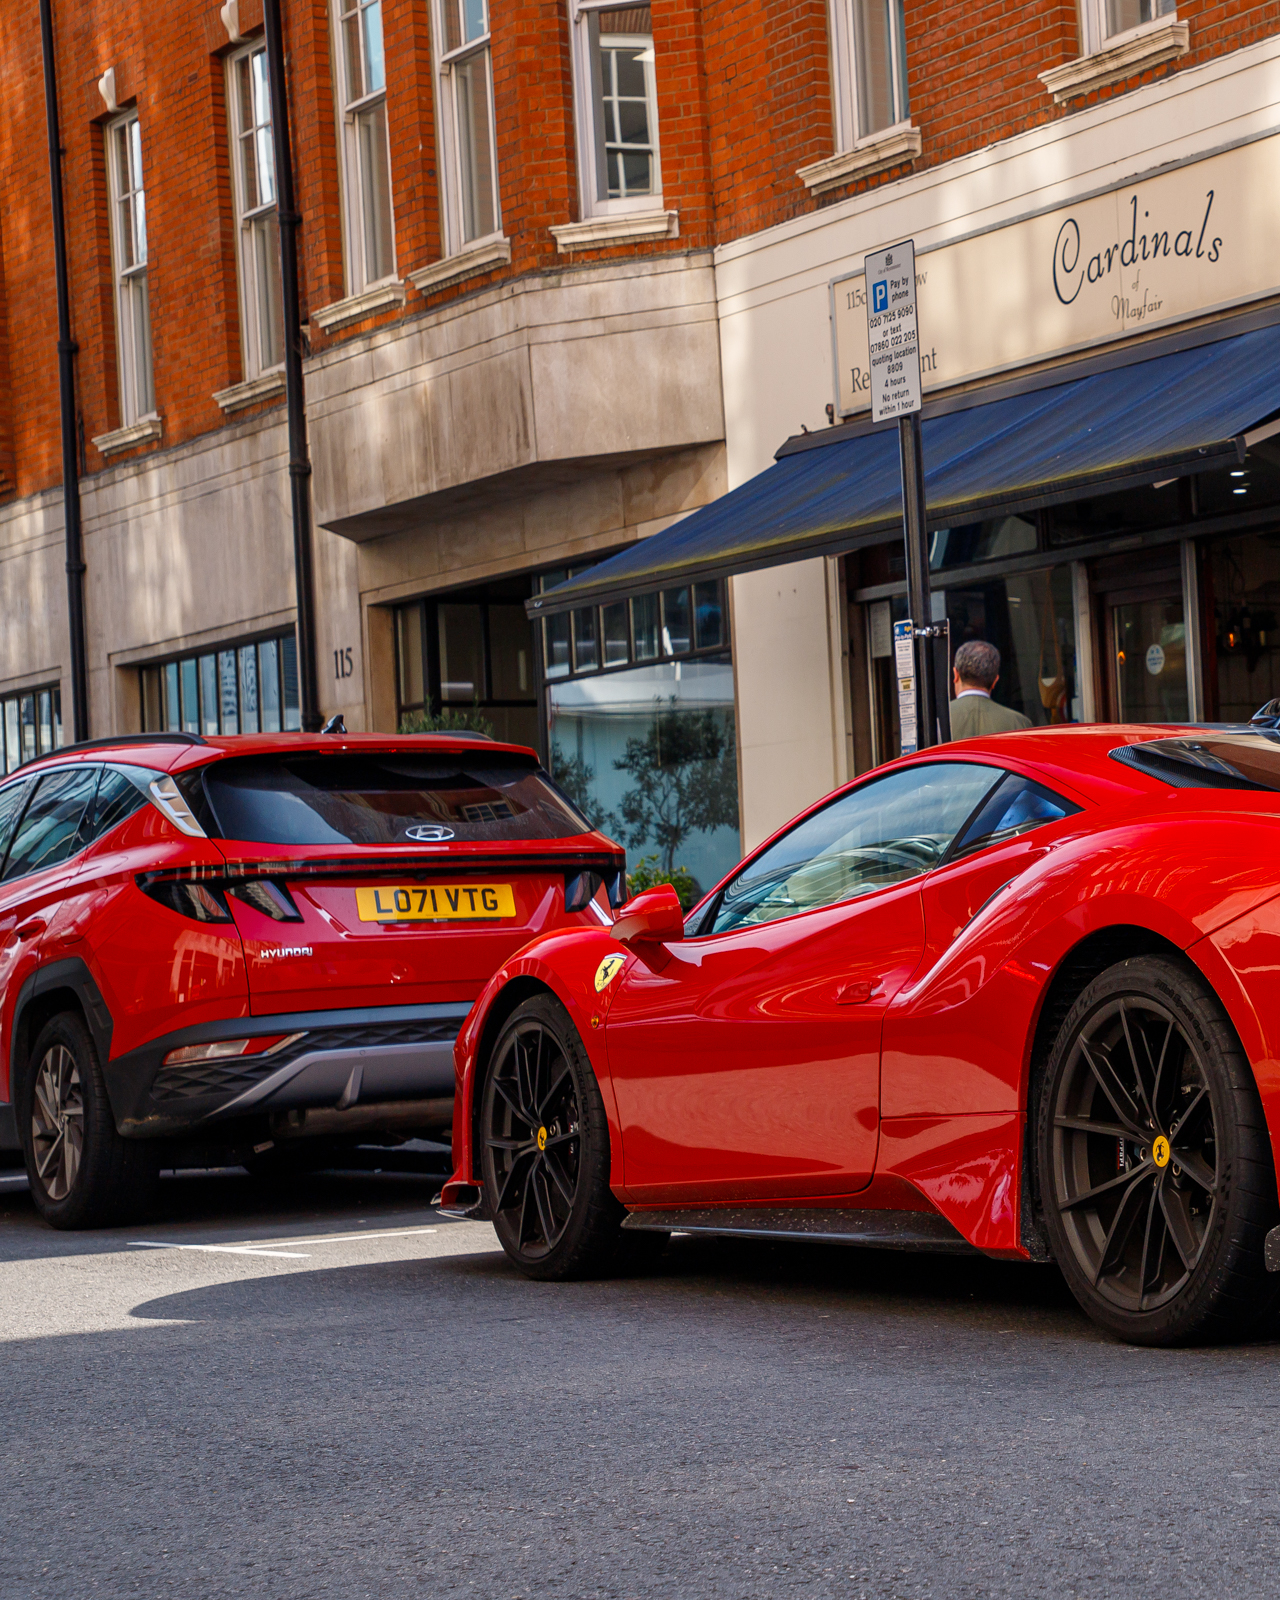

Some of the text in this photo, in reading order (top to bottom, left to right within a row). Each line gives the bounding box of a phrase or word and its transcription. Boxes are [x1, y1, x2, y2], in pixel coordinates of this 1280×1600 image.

[1052, 189, 1223, 305] Cardinals
[890, 276, 909, 289] Pay by
[1131, 269, 1141, 292] of
[876, 284, 886, 310] P
[892, 289, 909, 303] phone
[1111, 288, 1163, 320] Mayfair
[870, 305, 914, 328] 020 7125 9090
[890, 323, 902, 334] text
[891, 334, 902, 346] 022
[904, 330, 916, 342] 205
[872, 354, 893, 367] quoting
[894, 346, 917, 360] location
[887, 361, 904, 375] 8809
[884, 376, 906, 388] 4 hours
[882, 389, 910, 403] No return
[879, 403, 896, 416] within
[901, 400, 915, 410] hour
[333, 647, 353, 679] 115
[444, 888, 499, 912] VTG
[260, 946, 313, 959] HYUNDAI
